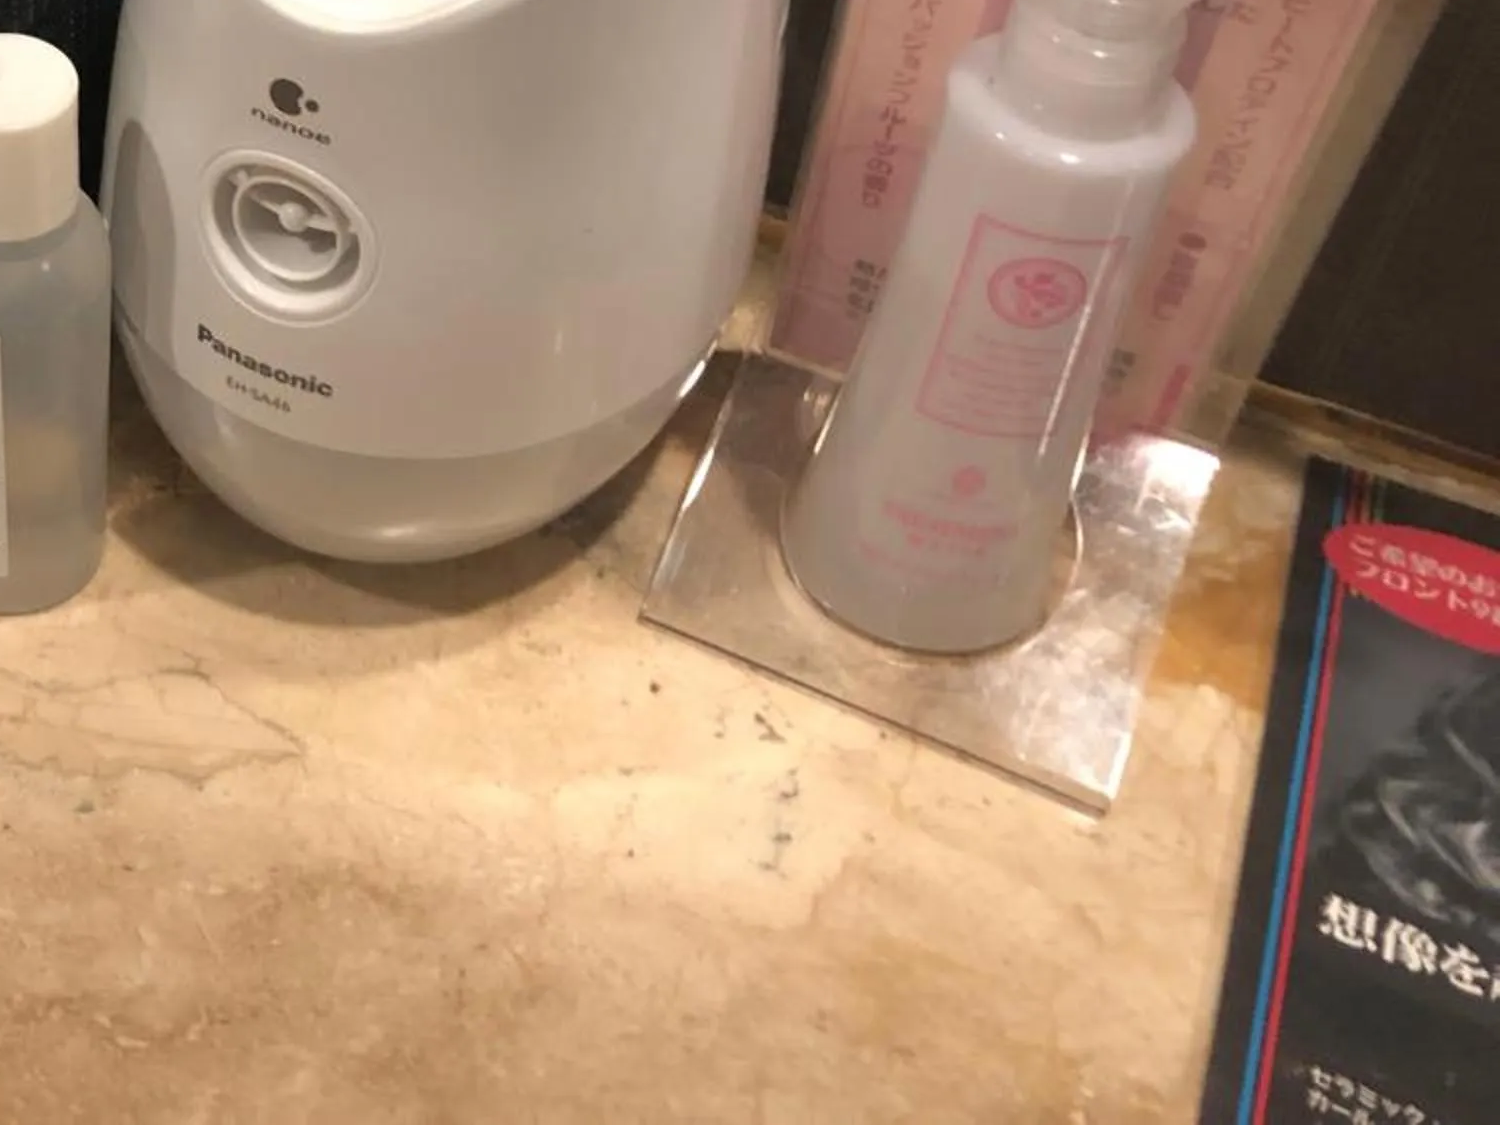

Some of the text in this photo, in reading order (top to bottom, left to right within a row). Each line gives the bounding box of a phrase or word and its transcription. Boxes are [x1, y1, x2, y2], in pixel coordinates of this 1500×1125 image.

[251, 107, 331, 146] nanoe
[197, 322, 333, 397] Panasonic
[1310, 1067, 1440, 1125] セラミック
